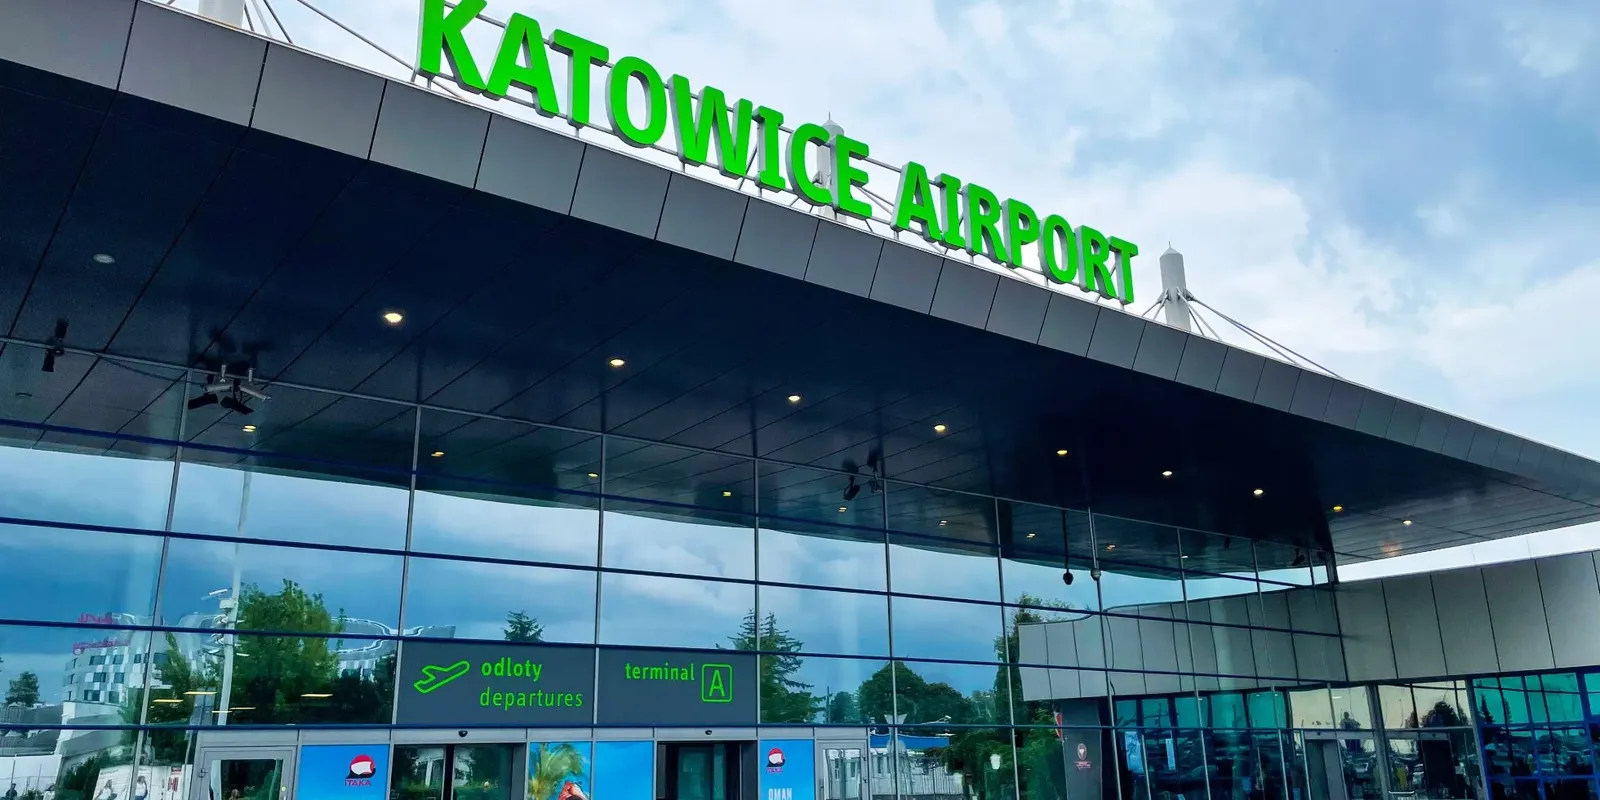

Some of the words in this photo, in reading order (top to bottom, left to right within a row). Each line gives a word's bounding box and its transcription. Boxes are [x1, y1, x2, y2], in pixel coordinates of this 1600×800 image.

[415, 0, 873, 219] KATOWICE
[892, 161, 1139, 304] AIRPORT
[480, 657, 543, 682] odloty
[625, 663, 695, 681] terminal
[708, 669, 726, 697] A
[479, 687, 583, 711] departures
[344, 779, 372, 787] ITAKA
[768, 788, 792, 800] OMAN
